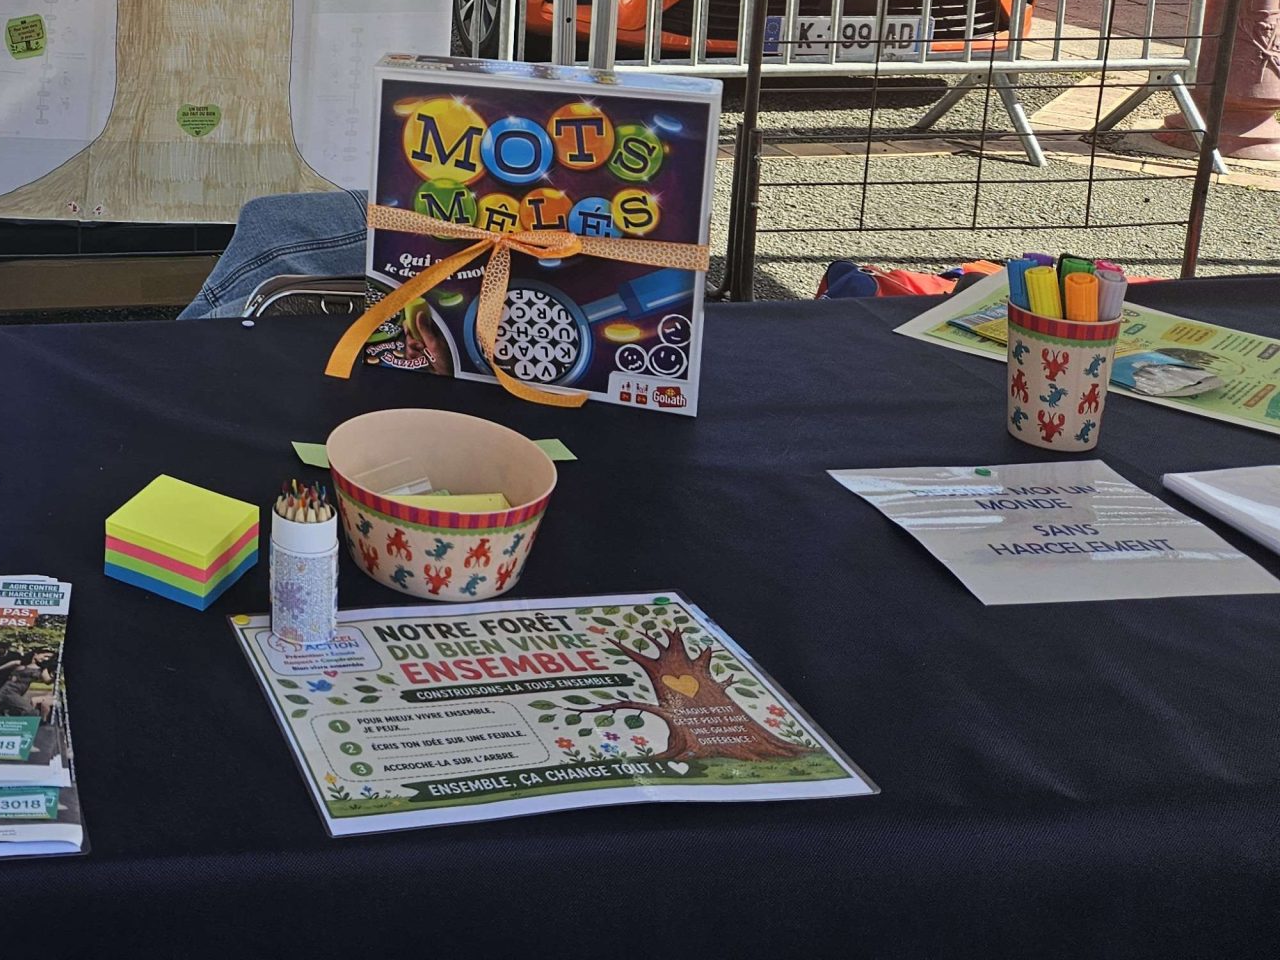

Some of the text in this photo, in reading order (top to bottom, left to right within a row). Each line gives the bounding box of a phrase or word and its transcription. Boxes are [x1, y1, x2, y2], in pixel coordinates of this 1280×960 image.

[412, 113, 658, 176] MOTS
[421, 190, 654, 236] MÊLÉS
[400, 253, 430, 268] Qui
[380, 351, 429, 370] Buzzez
[653, 390, 686, 406] Goliath
[1007, 486, 1058, 496] MOI
[1066, 485, 1096, 495] UN
[975, 498, 1072, 510] MONDE
[1033, 524, 1100, 537] SANS
[988, 540, 1175, 556] HARCELEMENT
[2, 608, 34, 618] PAS,
[373, 613, 573, 642] NOTRE FORÊT
[386, 633, 597, 661] DU BIEN VIVRE
[400, 650, 609, 685] ENSEMBLE
[417, 677, 614, 700] CONSTRUISONS-LA TOUS ENSEMBLE
[357, 707, 495, 726] POUR MIEUX VIVRE ENSEMBLE,
[673, 705, 734, 718] CHAQUE PETIT
[673, 715, 749, 726] GESTE PEUT FAIRE
[362, 726, 374, 734] JE
[690, 725, 747, 734] UNE GRANDE
[371, 741, 399, 752] ÉCRIS
[401, 740, 420, 749] TON
[422, 737, 443, 747] IDÉE
[466, 734, 486, 742] UNE
[488, 730, 526, 741] FEUILLE.
[384, 751, 519, 772] ACCROCHE-LA SUR L'ARBRE.
[428, 762, 653, 796] ENSEMBLE, ÇA CHANGE TOUT
[0, 800, 41, 809] 3018
